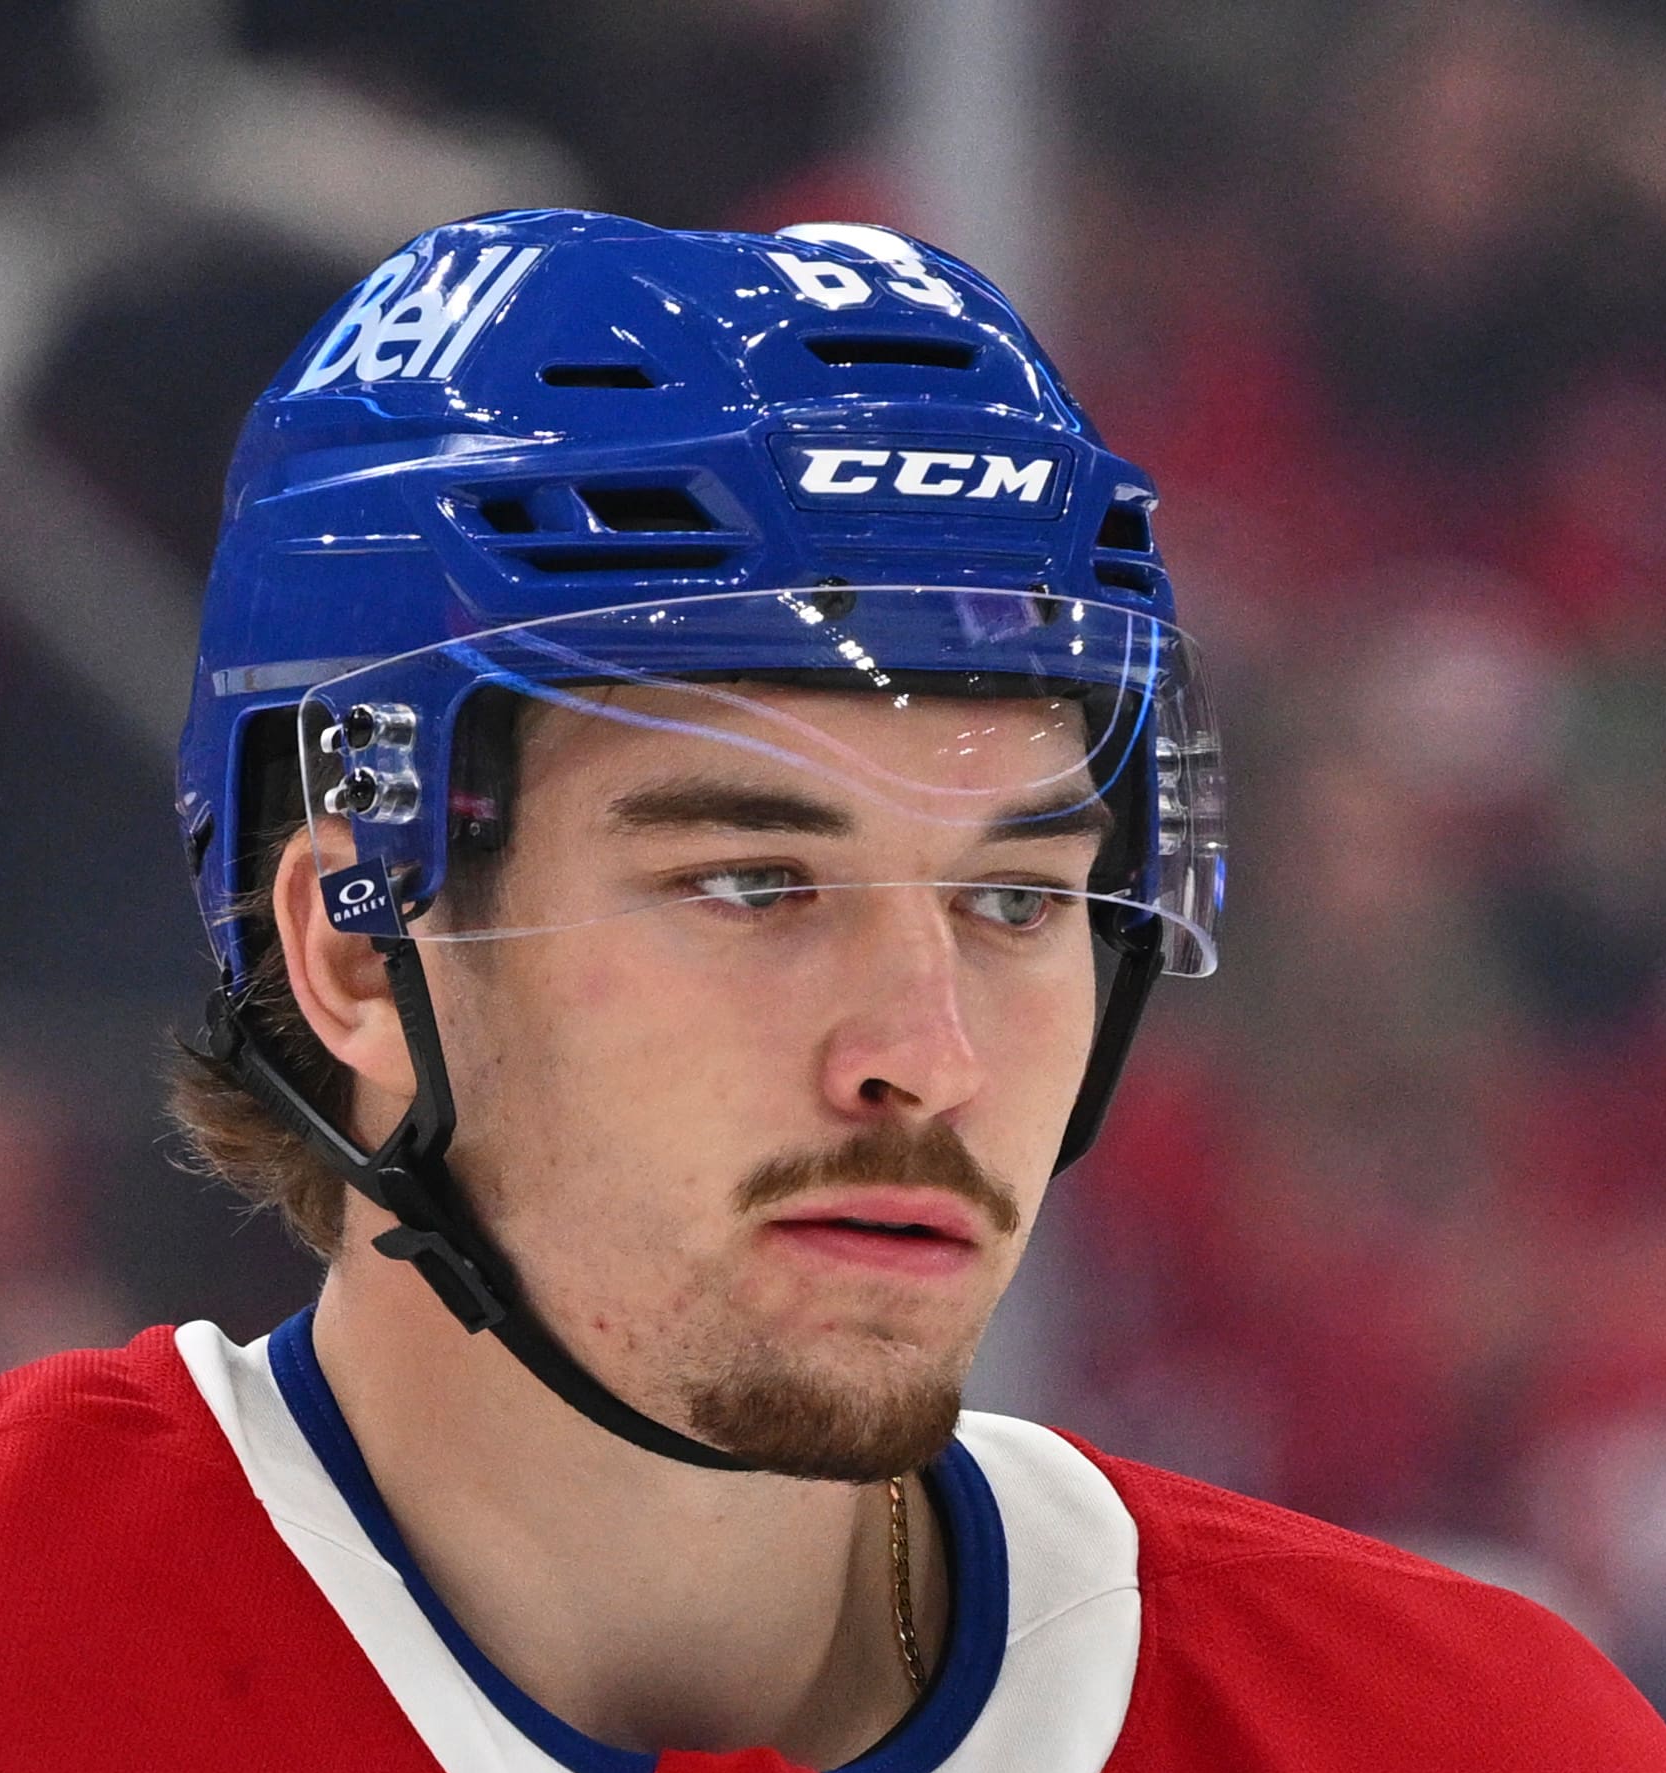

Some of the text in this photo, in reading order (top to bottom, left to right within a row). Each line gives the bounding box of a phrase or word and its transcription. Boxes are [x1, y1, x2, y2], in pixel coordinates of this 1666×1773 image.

[283, 246, 543, 398] Bell
[799, 450, 1054, 502] CCM
[333, 895, 386, 922] OAKLEY
